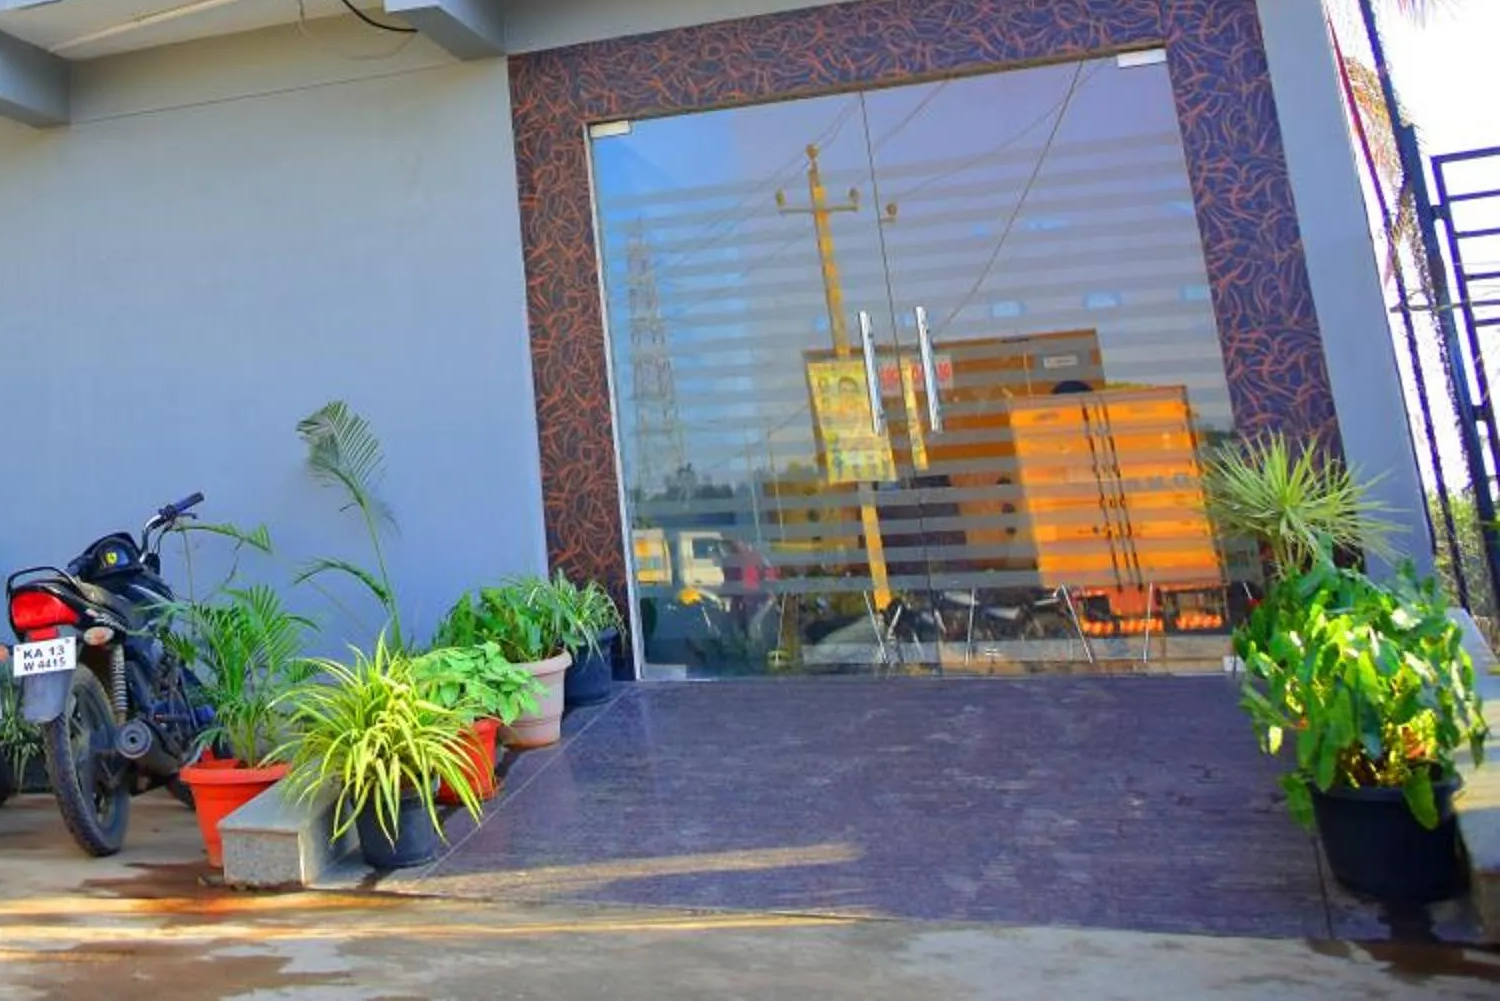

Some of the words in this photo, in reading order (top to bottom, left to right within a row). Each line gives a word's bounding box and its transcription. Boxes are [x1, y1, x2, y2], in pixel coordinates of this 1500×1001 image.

[23, 648, 44, 660] KA
[48, 644, 66, 656] 13
[23, 660, 35, 672] W
